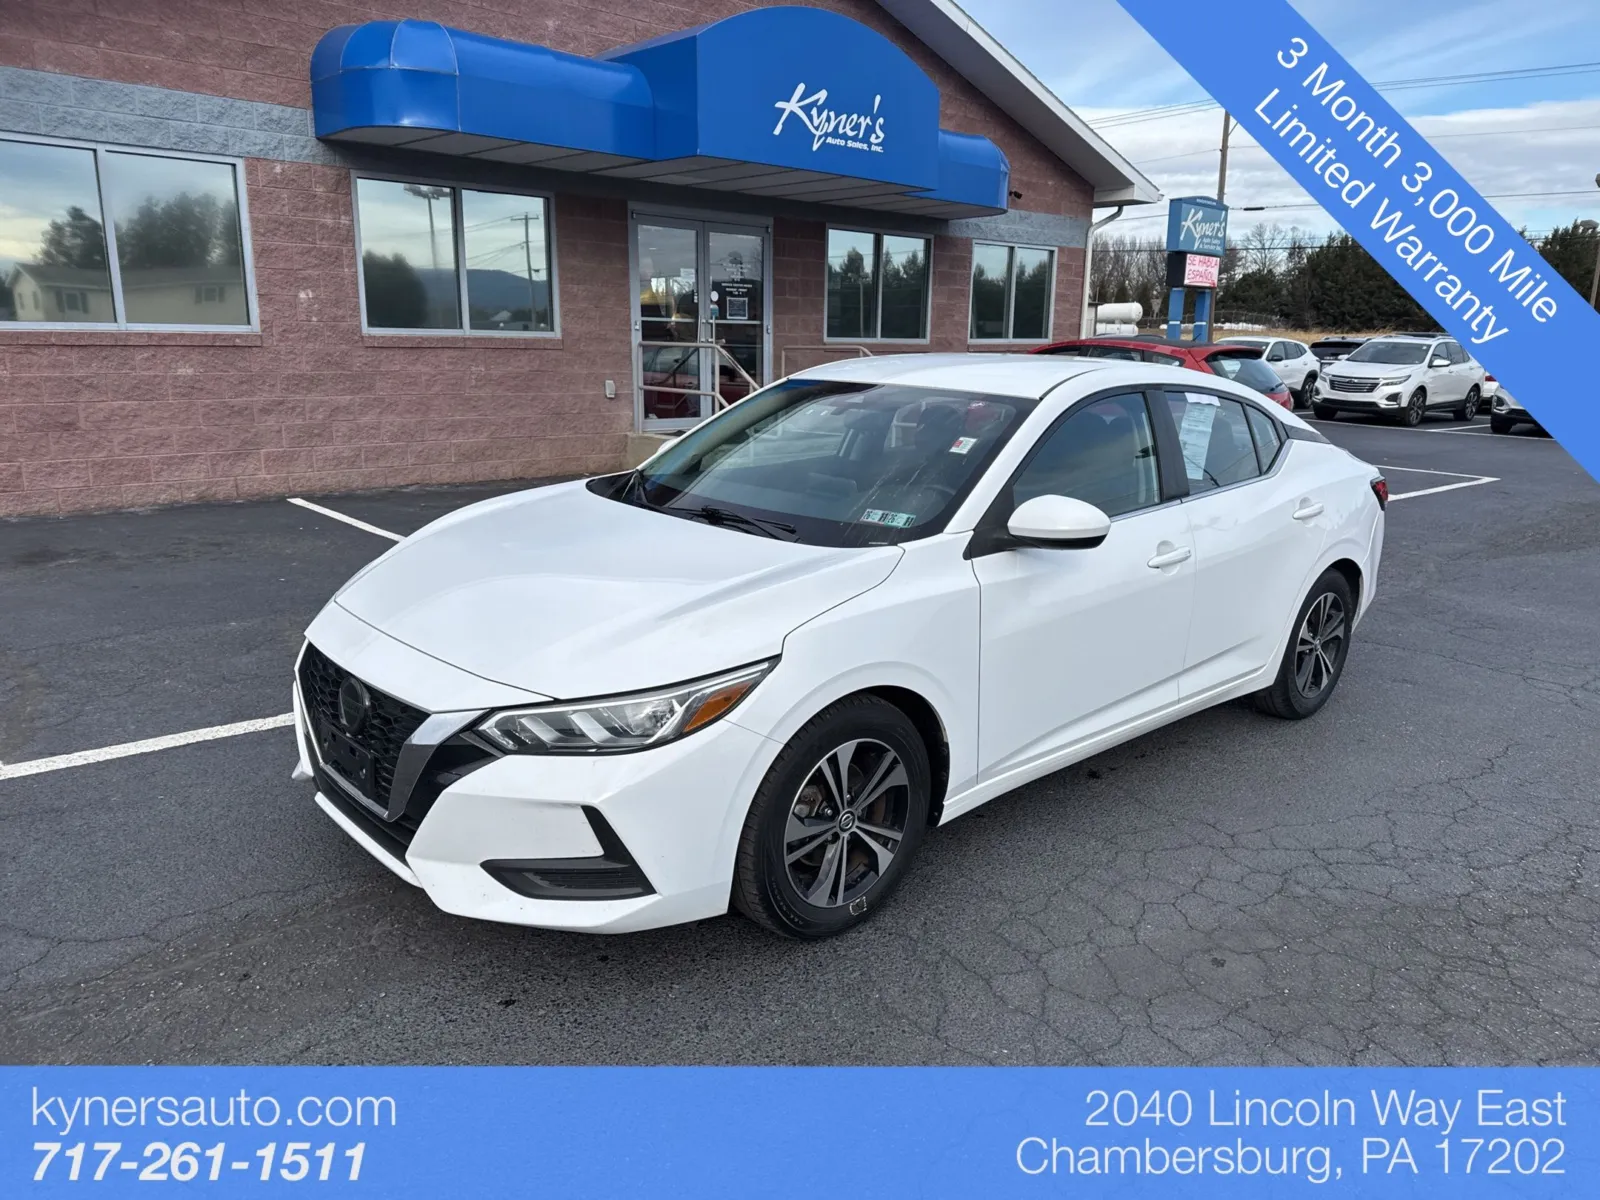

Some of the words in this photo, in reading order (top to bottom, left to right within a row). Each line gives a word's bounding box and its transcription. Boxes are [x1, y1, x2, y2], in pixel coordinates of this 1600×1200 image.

[773, 82, 885, 152] Kyner's
[826, 136, 846, 147] Auto
[847, 140, 869, 151] Sales,
[871, 144, 884, 153] Inc.
[1180, 208, 1225, 250] Kyner's
[1188, 255, 1197, 266] SE
[1198, 257, 1218, 268] HABLA
[1188, 268, 1215, 281] ESPAÑOL
